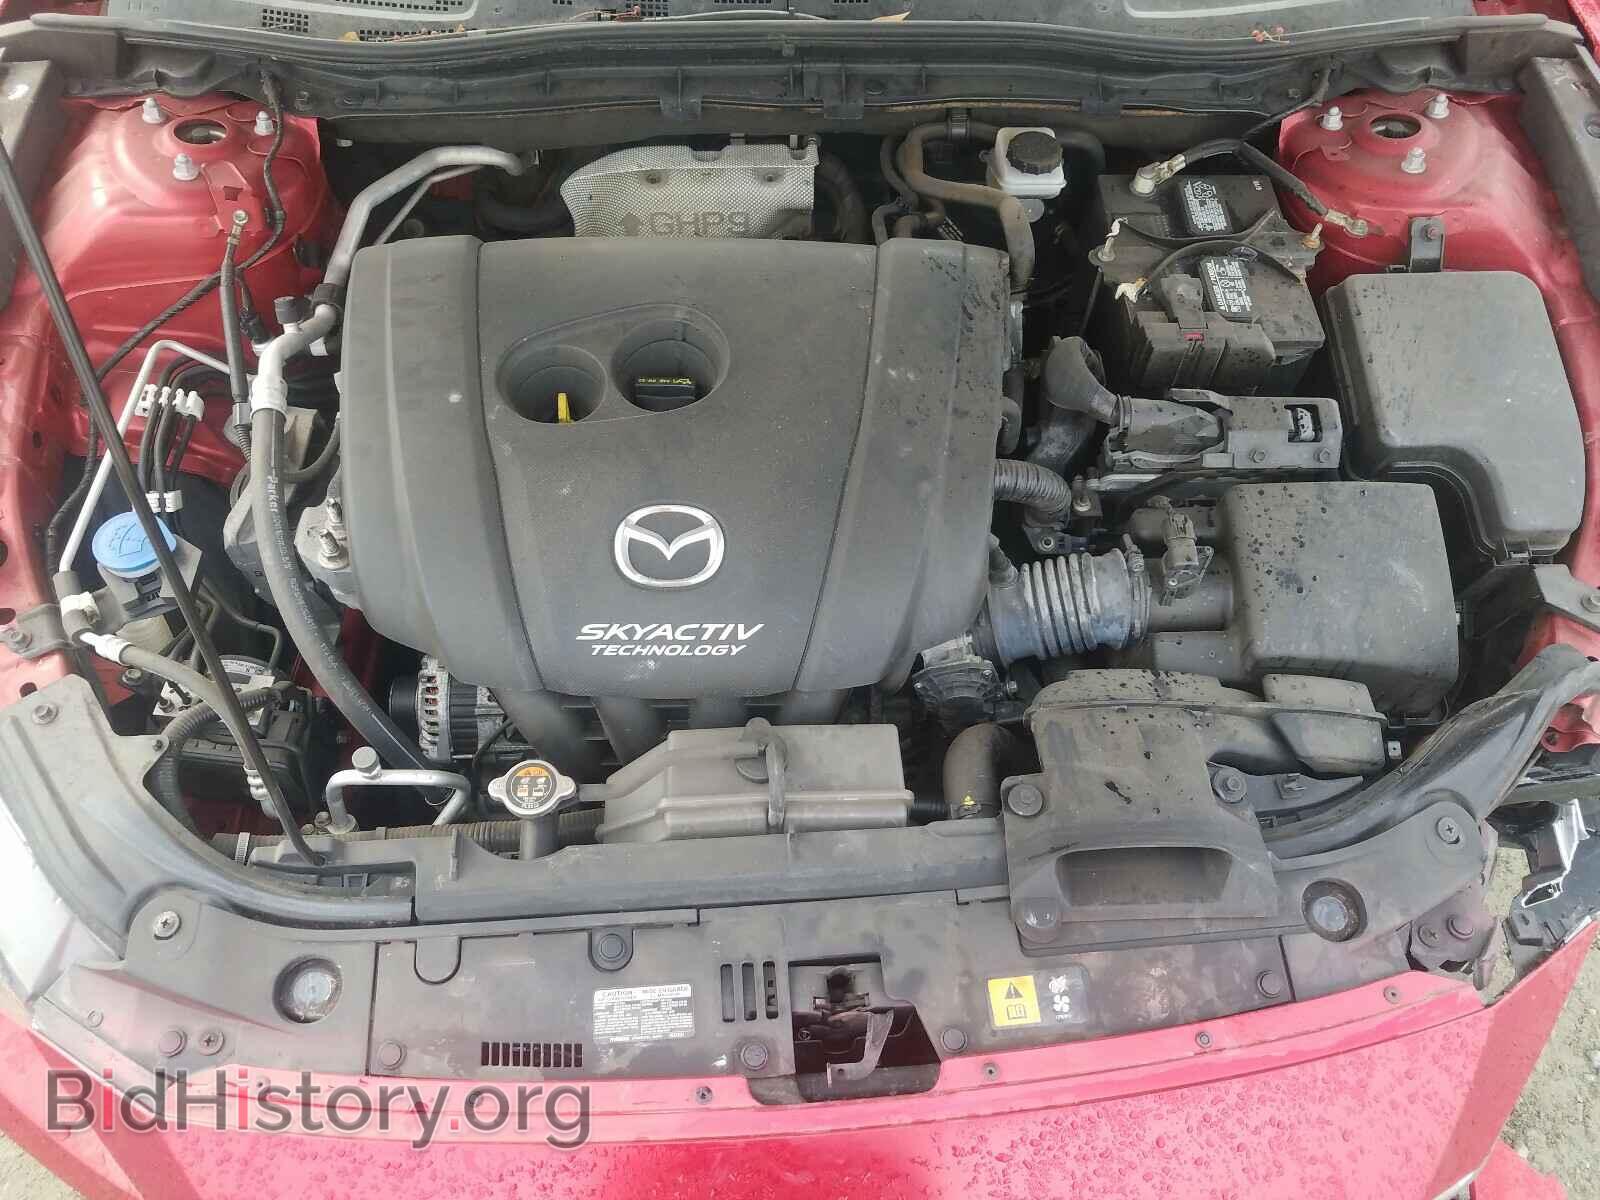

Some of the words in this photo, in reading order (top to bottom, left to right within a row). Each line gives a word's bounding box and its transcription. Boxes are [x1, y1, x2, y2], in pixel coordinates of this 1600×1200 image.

[267, 475, 280, 513] Parker
[575, 623, 766, 641] SKYACTIV
[591, 644, 748, 656] TECHNOLOGY
